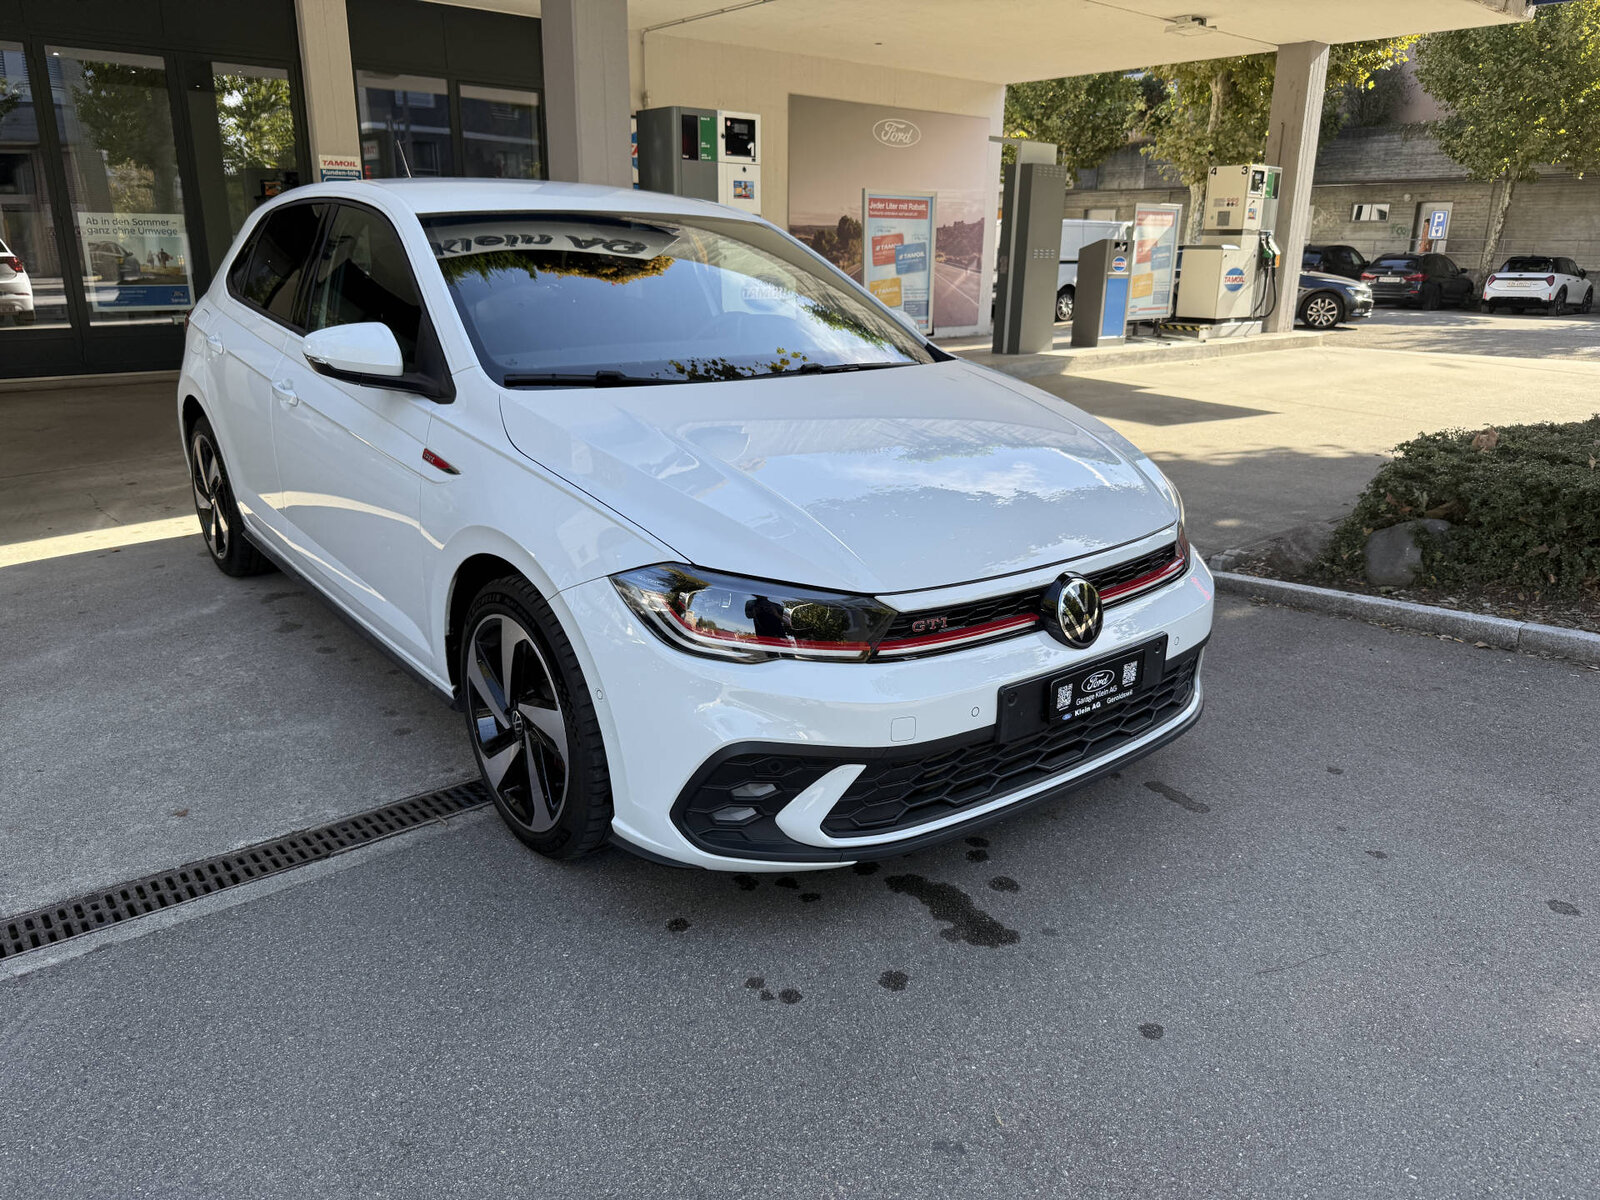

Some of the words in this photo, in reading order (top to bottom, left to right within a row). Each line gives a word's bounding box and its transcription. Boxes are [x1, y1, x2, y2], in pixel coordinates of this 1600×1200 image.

[879, 120, 916, 145] Ford
[746, 142, 755, 157] 1
[322, 160, 358, 168] TAMOIL
[322, 169, 359, 177] Kunden-Info
[1210, 167, 1217, 175] 4
[1241, 166, 1248, 175] 3
[869, 201, 885, 210] Jeder
[885, 202, 898, 210] Liter
[86, 217, 98, 225] Ab
[112, 217, 130, 226] den
[132, 218, 169, 226] Sommer
[1434, 213, 1444, 227] P
[87, 227, 110, 235] ganz
[137, 227, 178, 236] Umwege
[912, 616, 948, 632] GTI
[1085, 672, 1111, 691] Ford
[1075, 693, 1095, 706] Garage
[1095, 688, 1109, 699] Klein
[1108, 685, 1118, 693] AG
[1074, 706, 1091, 716] Klein
[1091, 702, 1101, 710] AG
